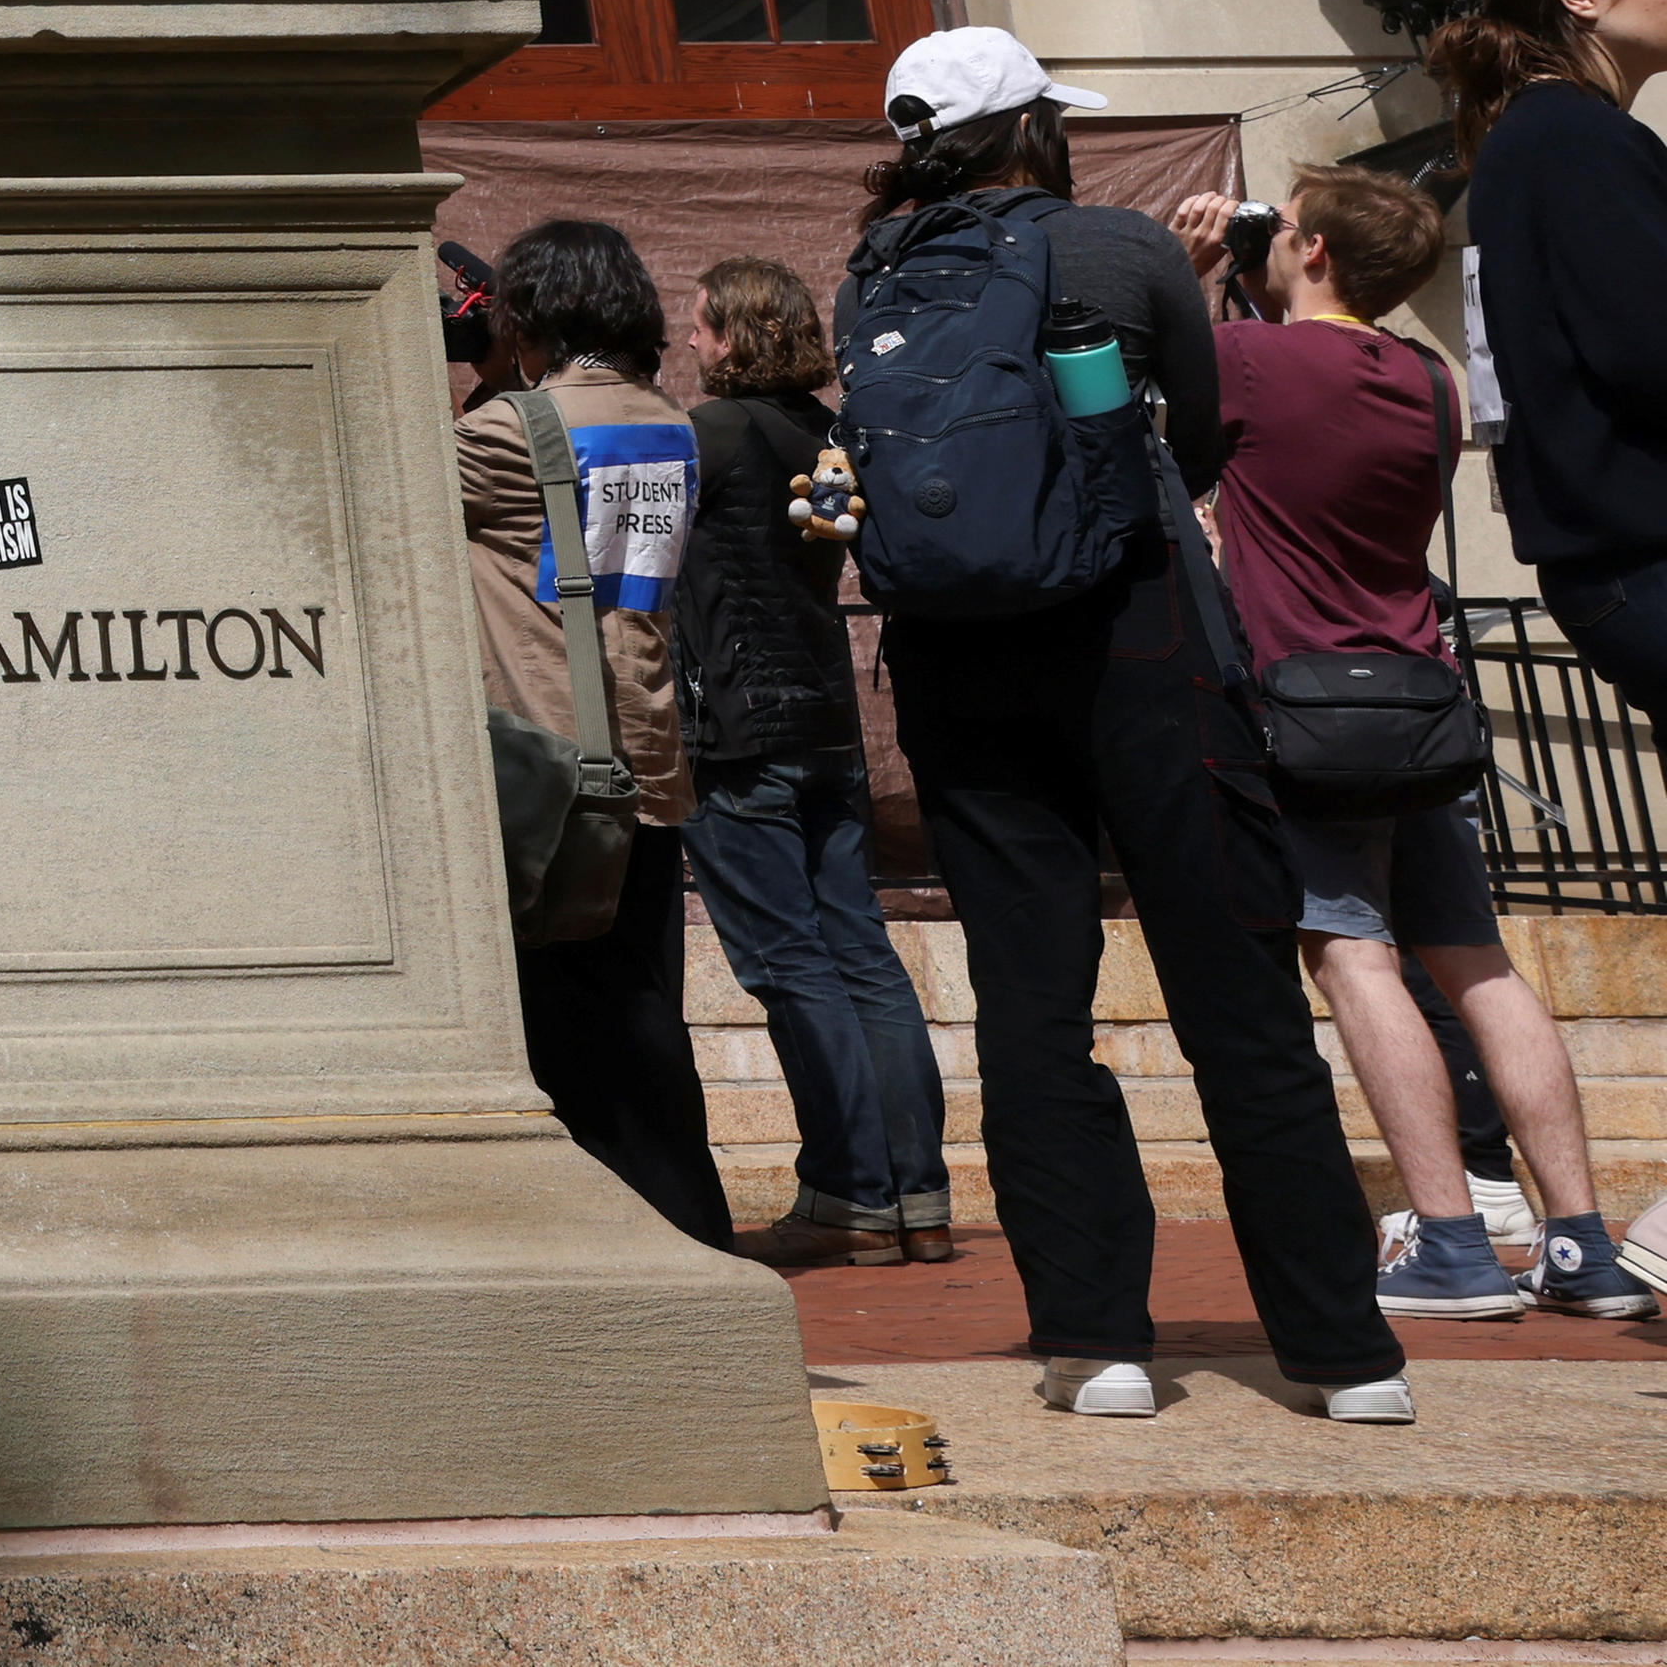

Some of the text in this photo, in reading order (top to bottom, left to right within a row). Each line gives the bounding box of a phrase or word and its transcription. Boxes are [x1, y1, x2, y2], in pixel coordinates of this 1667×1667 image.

[5, 484, 30, 521] IS
[602, 481, 682, 503] STUDENT
[616, 513, 673, 535] PRESS
